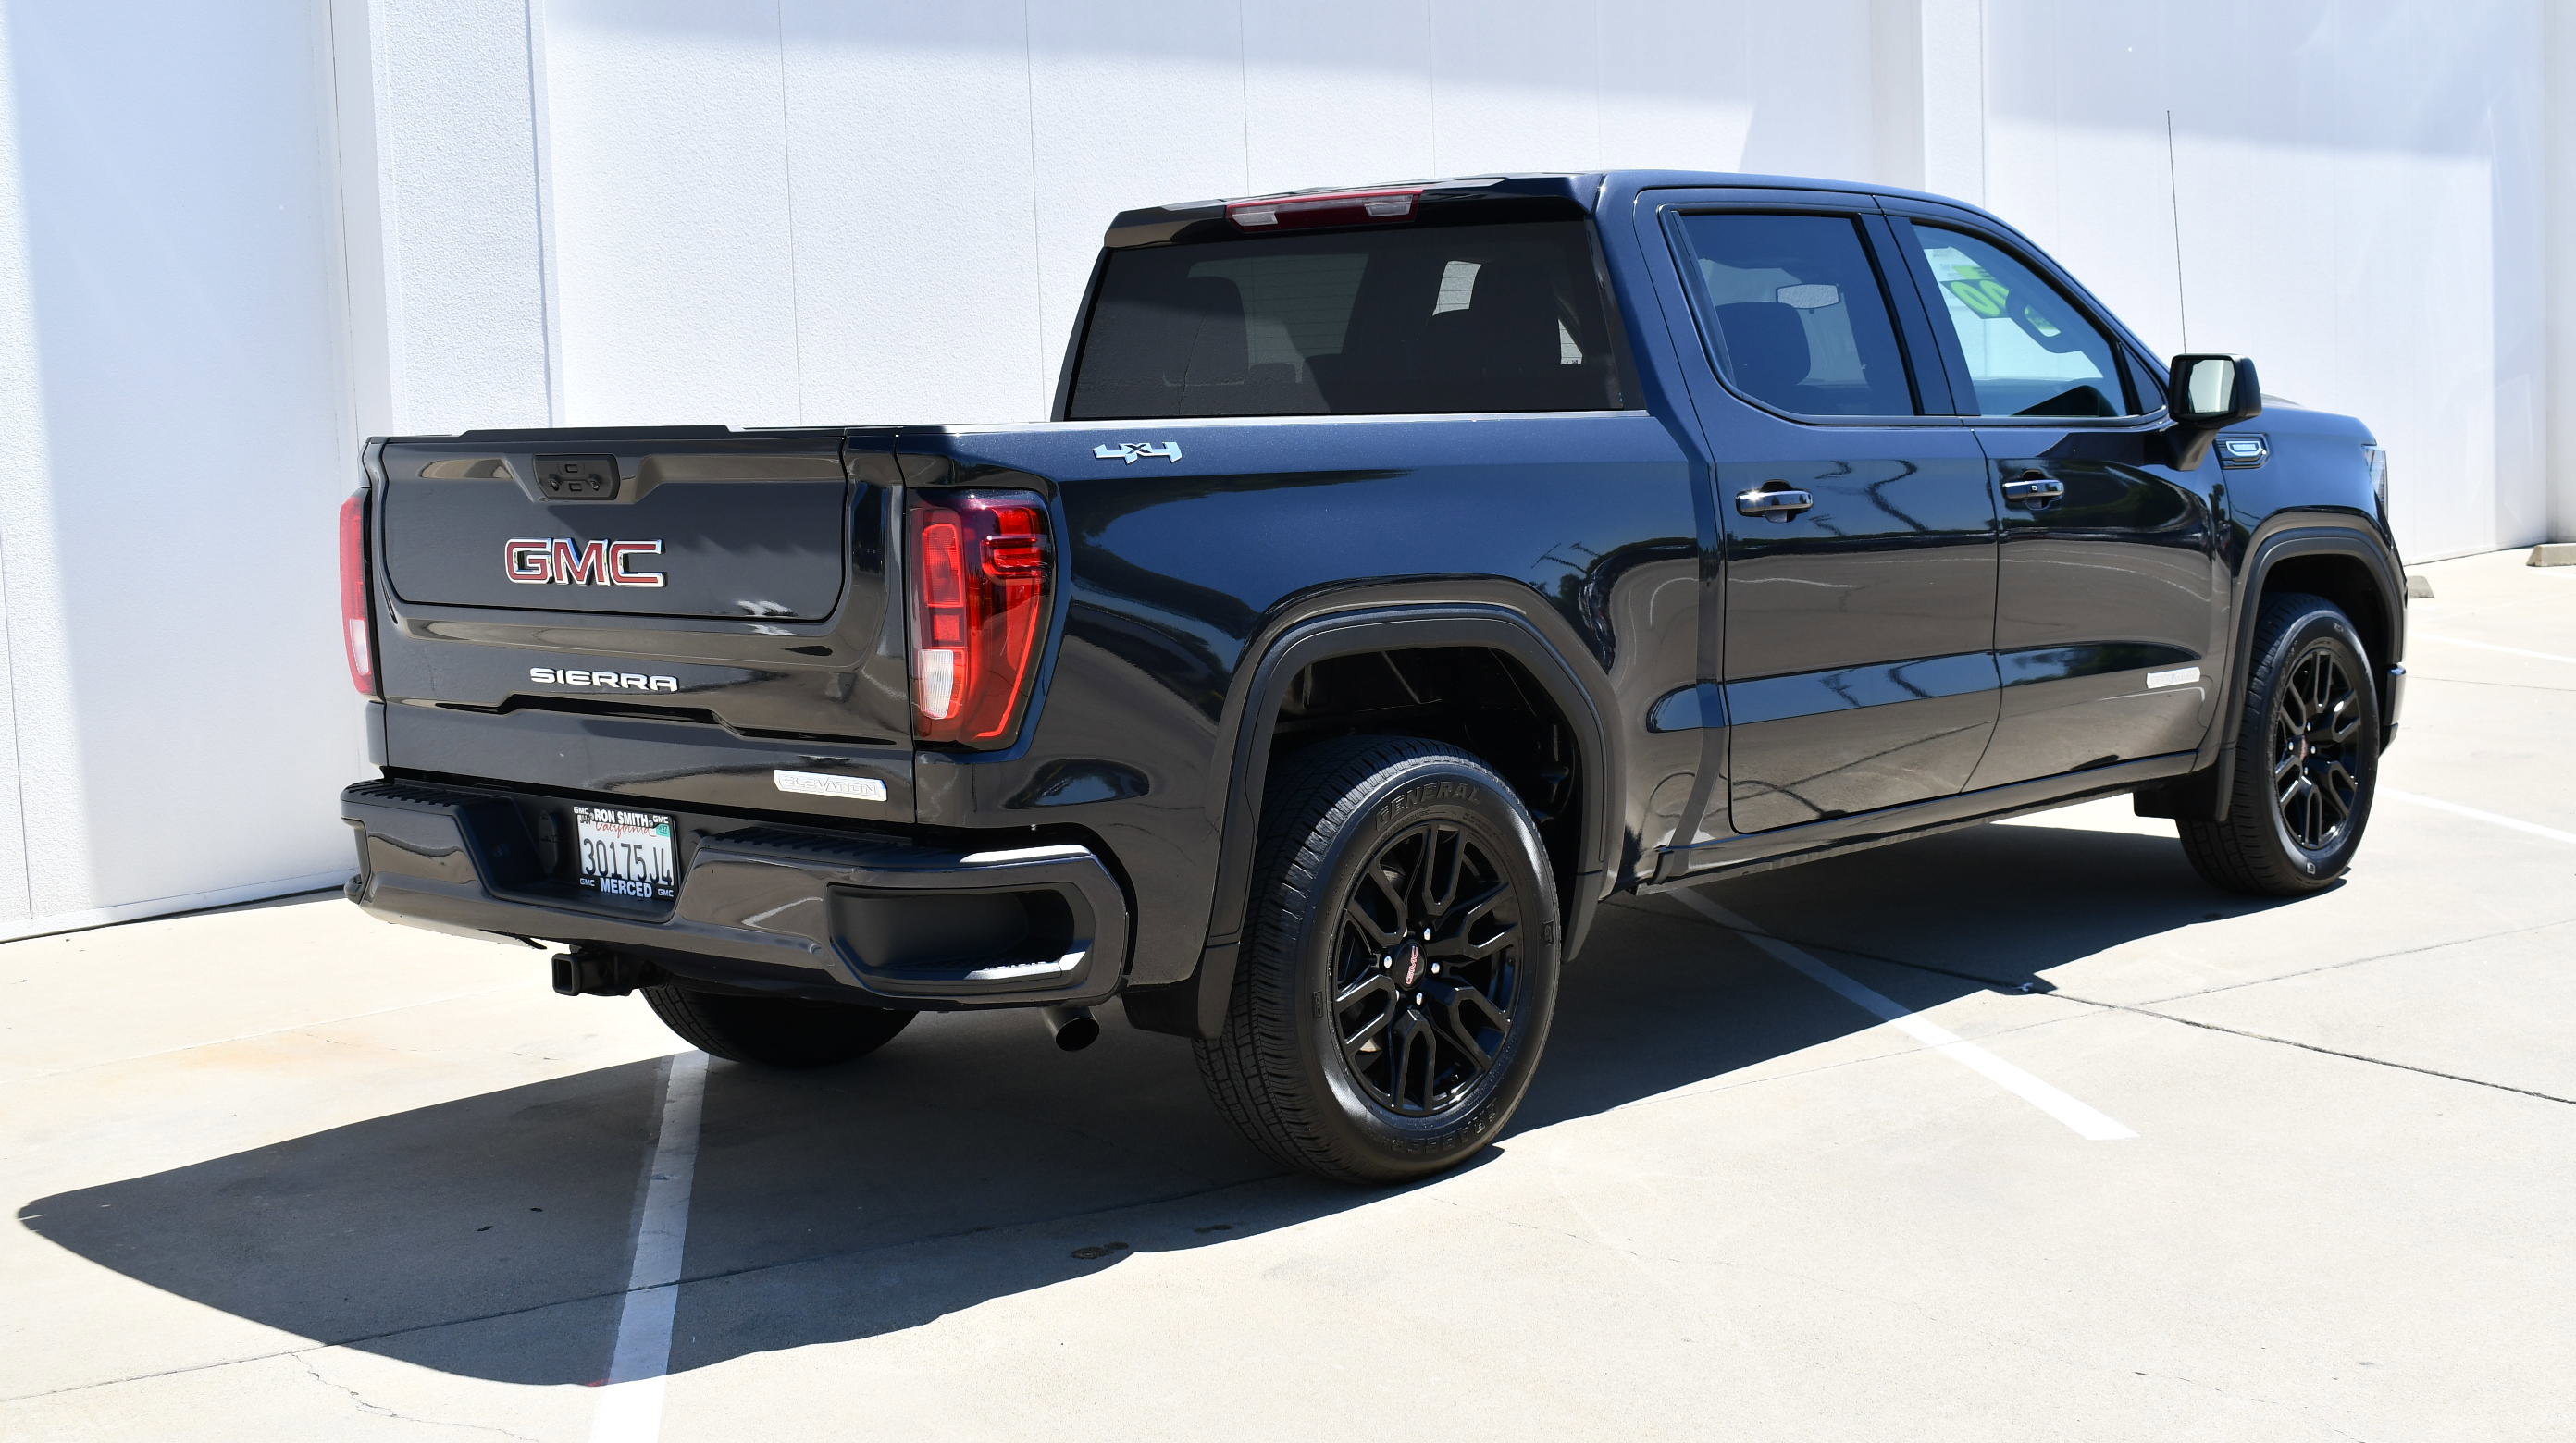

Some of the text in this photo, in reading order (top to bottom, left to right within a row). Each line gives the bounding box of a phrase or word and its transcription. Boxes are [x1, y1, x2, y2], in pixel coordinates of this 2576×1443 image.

[504, 537, 666, 588] GMC
[529, 667, 679, 693] SIERRA
[778, 775, 880, 797] ELEVATION
[574, 806, 589, 815] GMC
[1375, 780, 1482, 832] GENERAL
[593, 808, 649, 828] RON SMITH
[652, 815, 668, 824] GMC
[579, 878, 596, 887] GMC
[599, 877, 653, 898] MERCED
[657, 888, 675, 898] GMC
[1405, 945, 1418, 985] GMC
